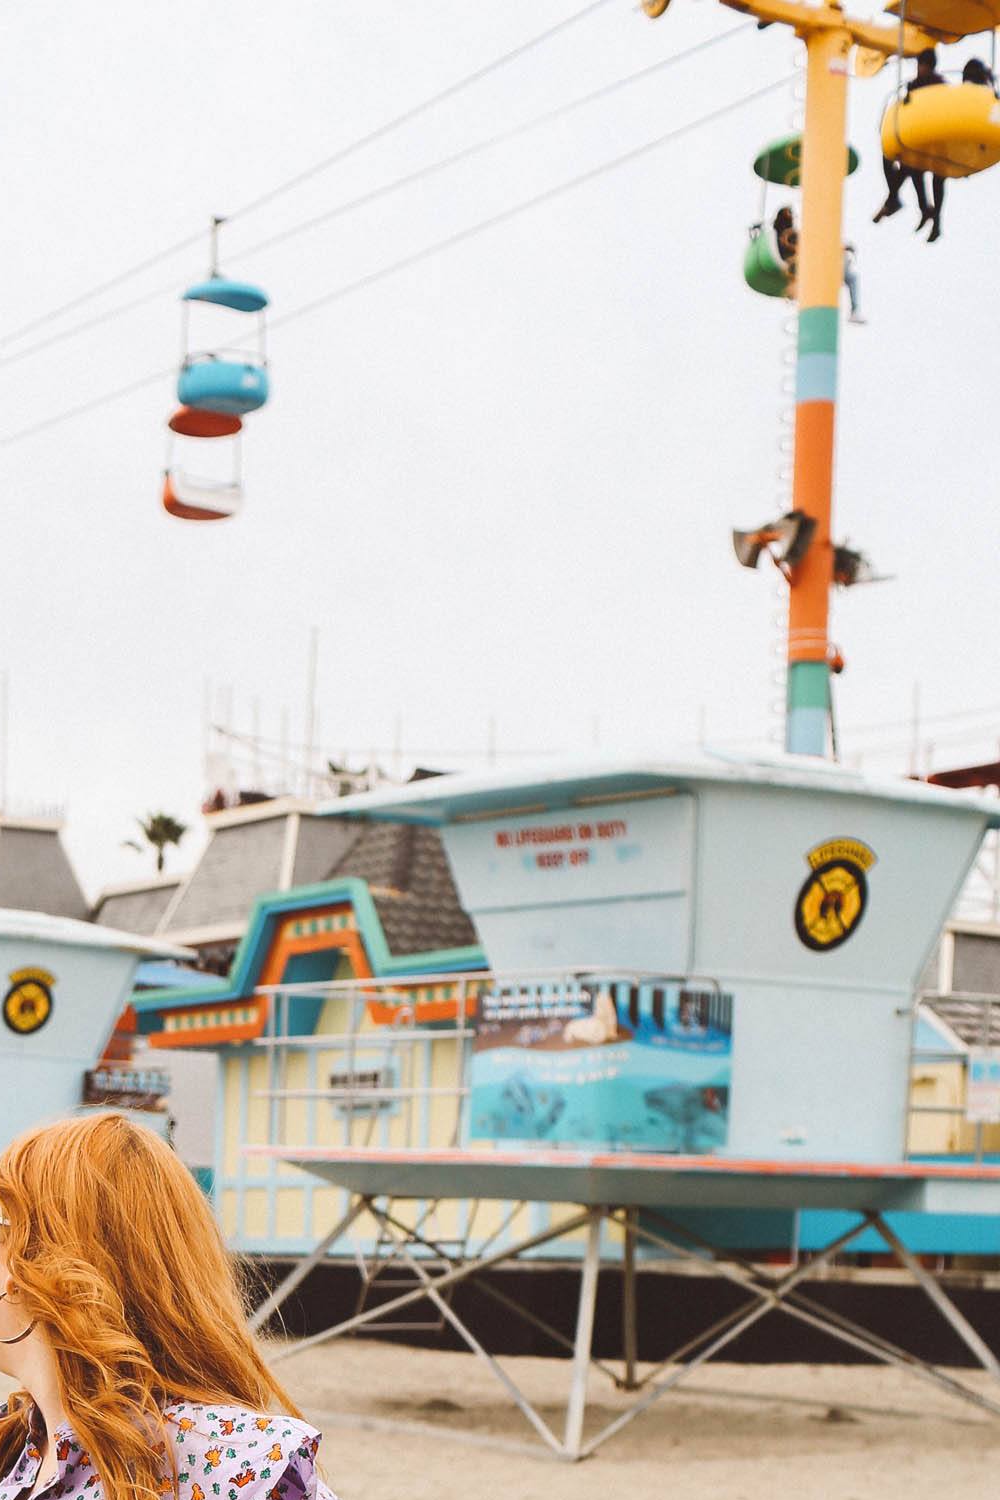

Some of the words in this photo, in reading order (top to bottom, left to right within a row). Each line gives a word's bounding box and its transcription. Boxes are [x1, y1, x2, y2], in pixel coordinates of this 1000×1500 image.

[516, 826, 573, 845] LIFEGUARD
[578, 824, 592, 839] ON
[597, 820, 627, 838] DUTY
